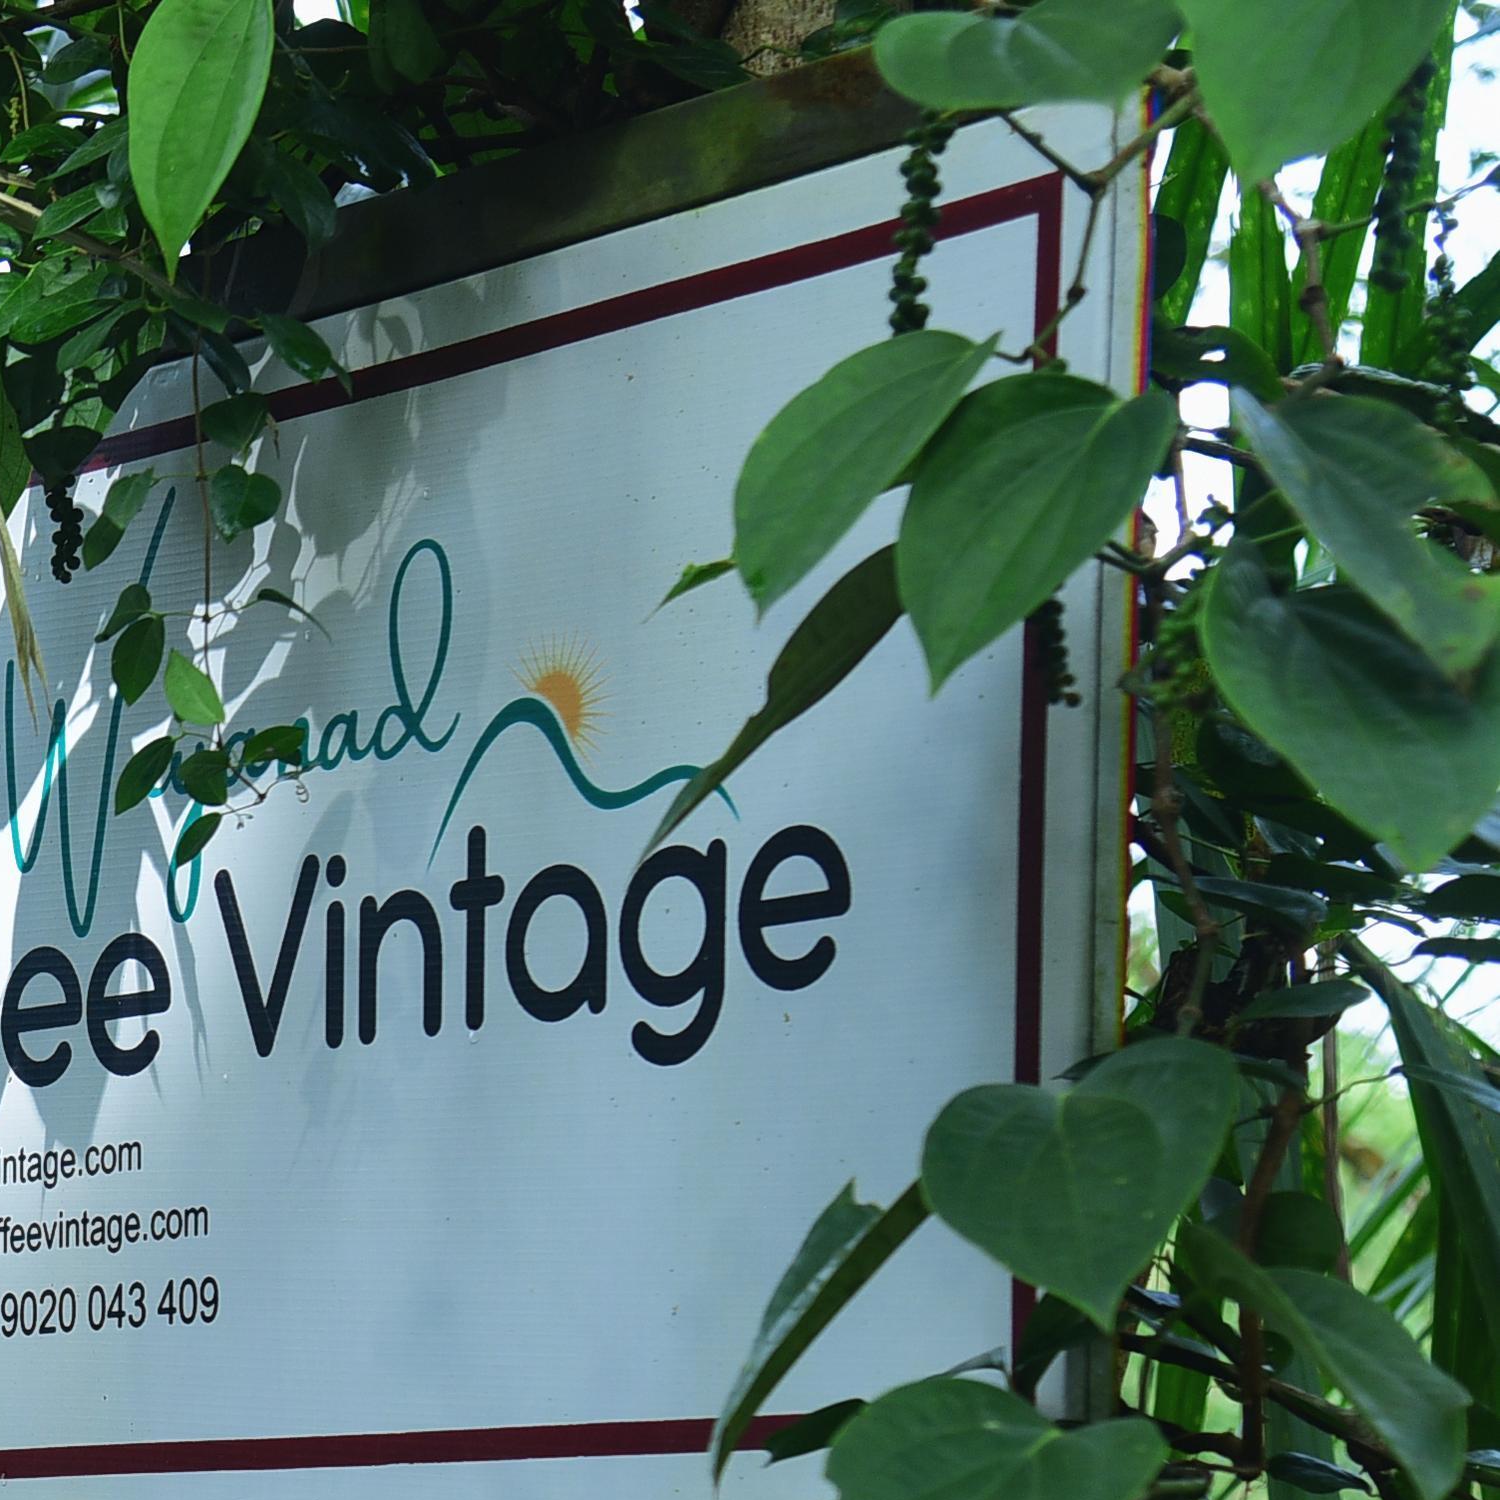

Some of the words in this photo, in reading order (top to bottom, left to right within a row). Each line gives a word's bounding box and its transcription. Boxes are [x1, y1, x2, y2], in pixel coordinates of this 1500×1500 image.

[213, 823, 852, 1068] Vintage
[0, 1286, 78, 1339] 9020
[87, 1280, 148, 1332] 043
[156, 1275, 220, 1326] 409
